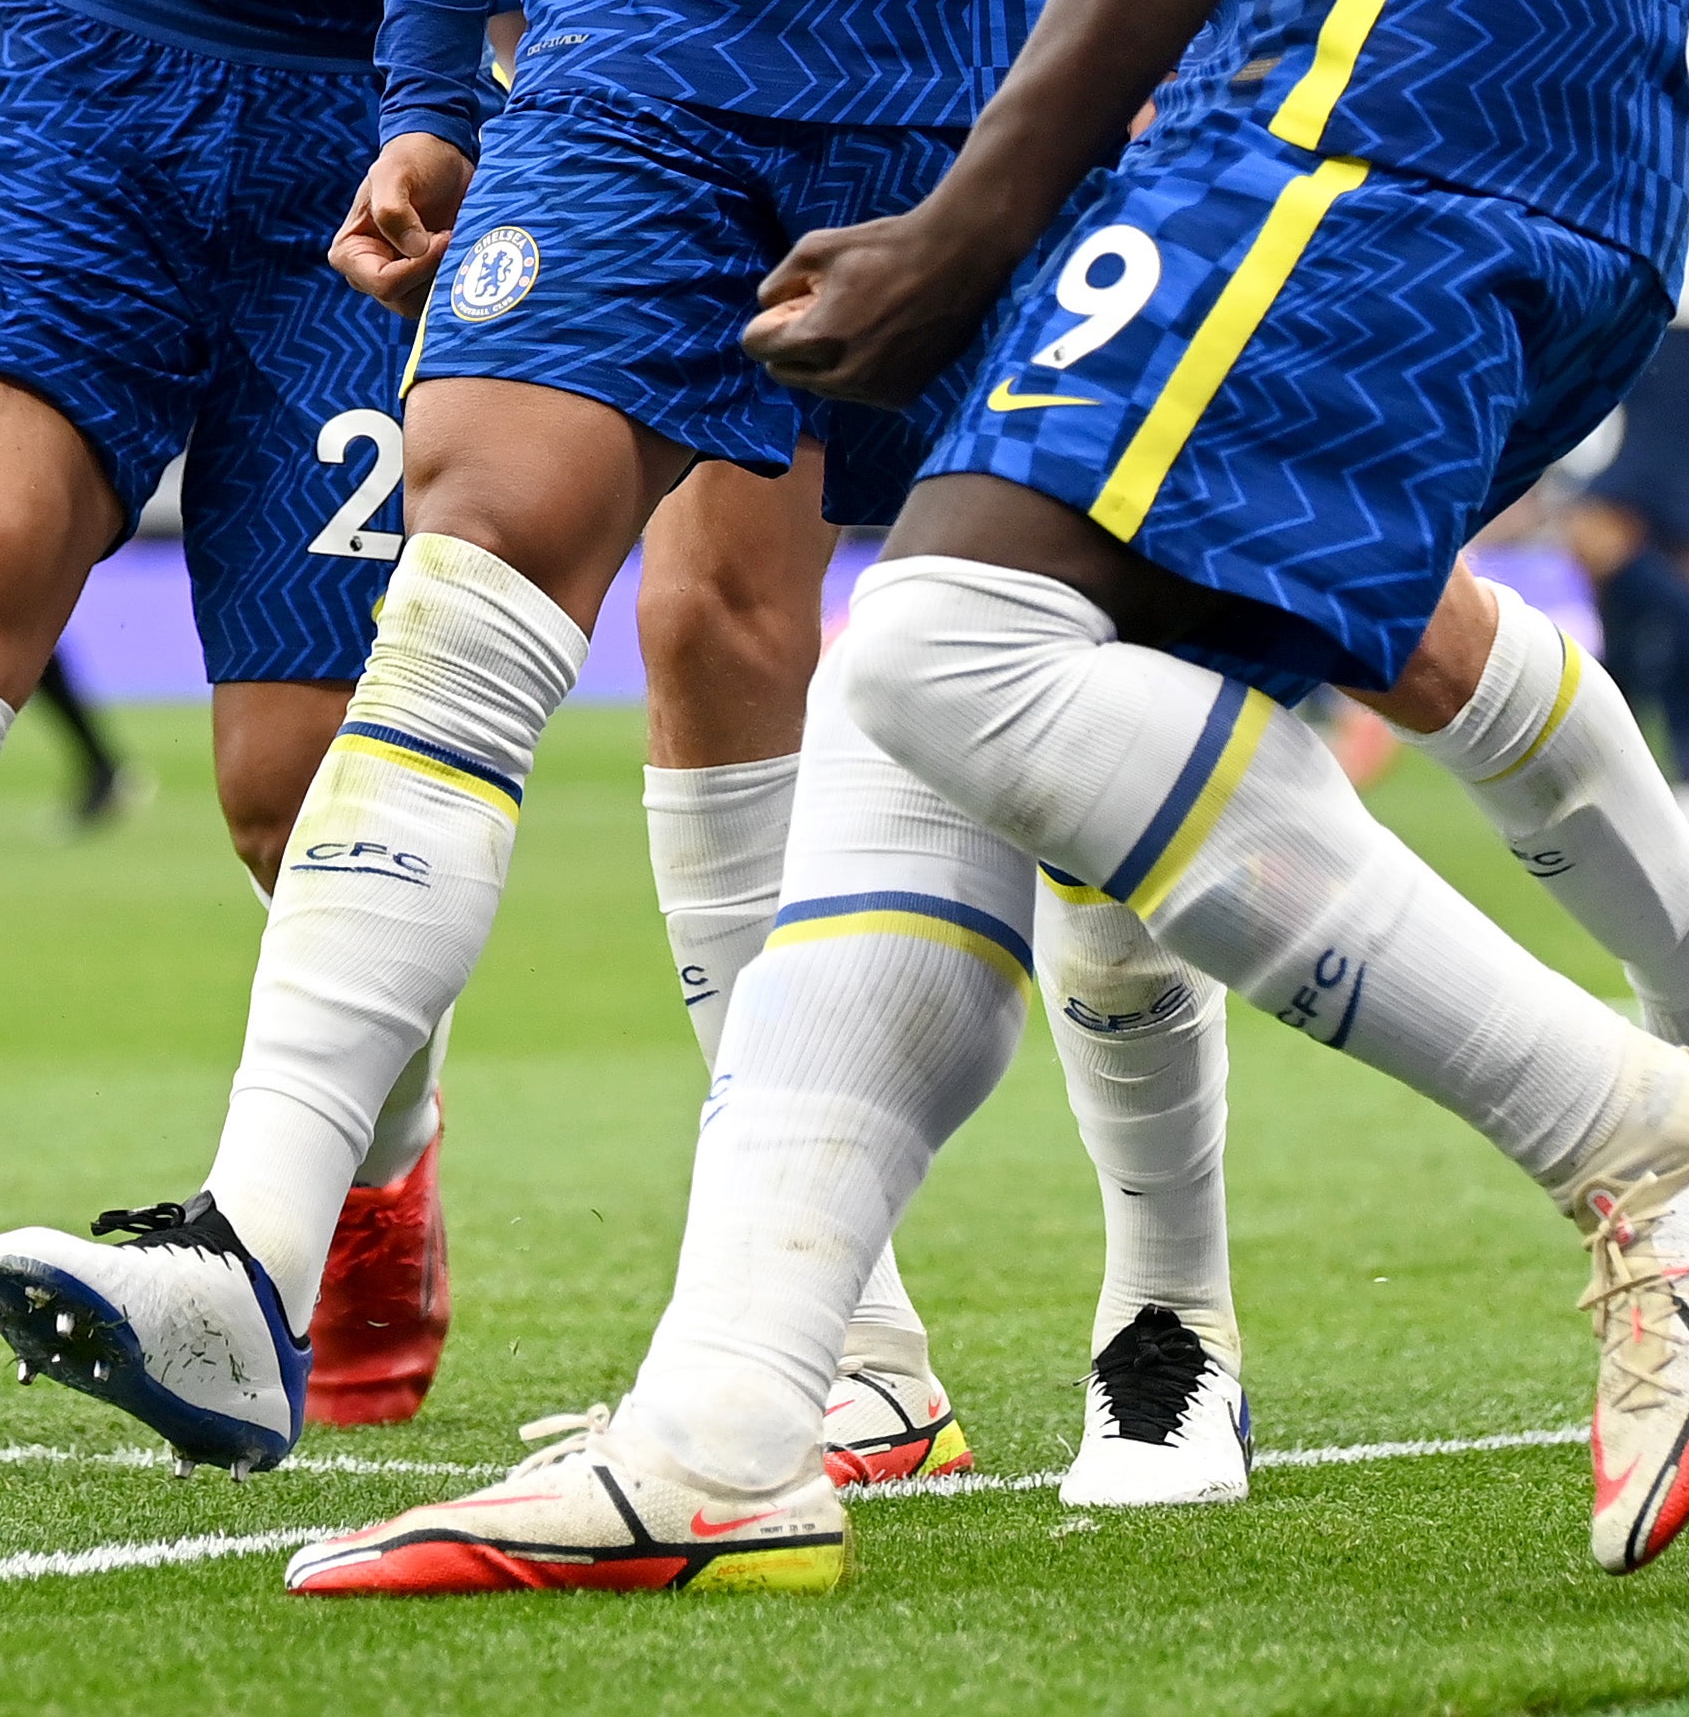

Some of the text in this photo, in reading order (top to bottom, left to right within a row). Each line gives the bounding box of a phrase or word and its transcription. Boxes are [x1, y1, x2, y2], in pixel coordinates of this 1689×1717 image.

[474, 230, 528, 254] CHELSEA
[1031, 224, 1161, 369] 9
[307, 408, 404, 561] 2
[306, 842, 432, 875] CFC
[1277, 946, 1347, 1028] CFC
